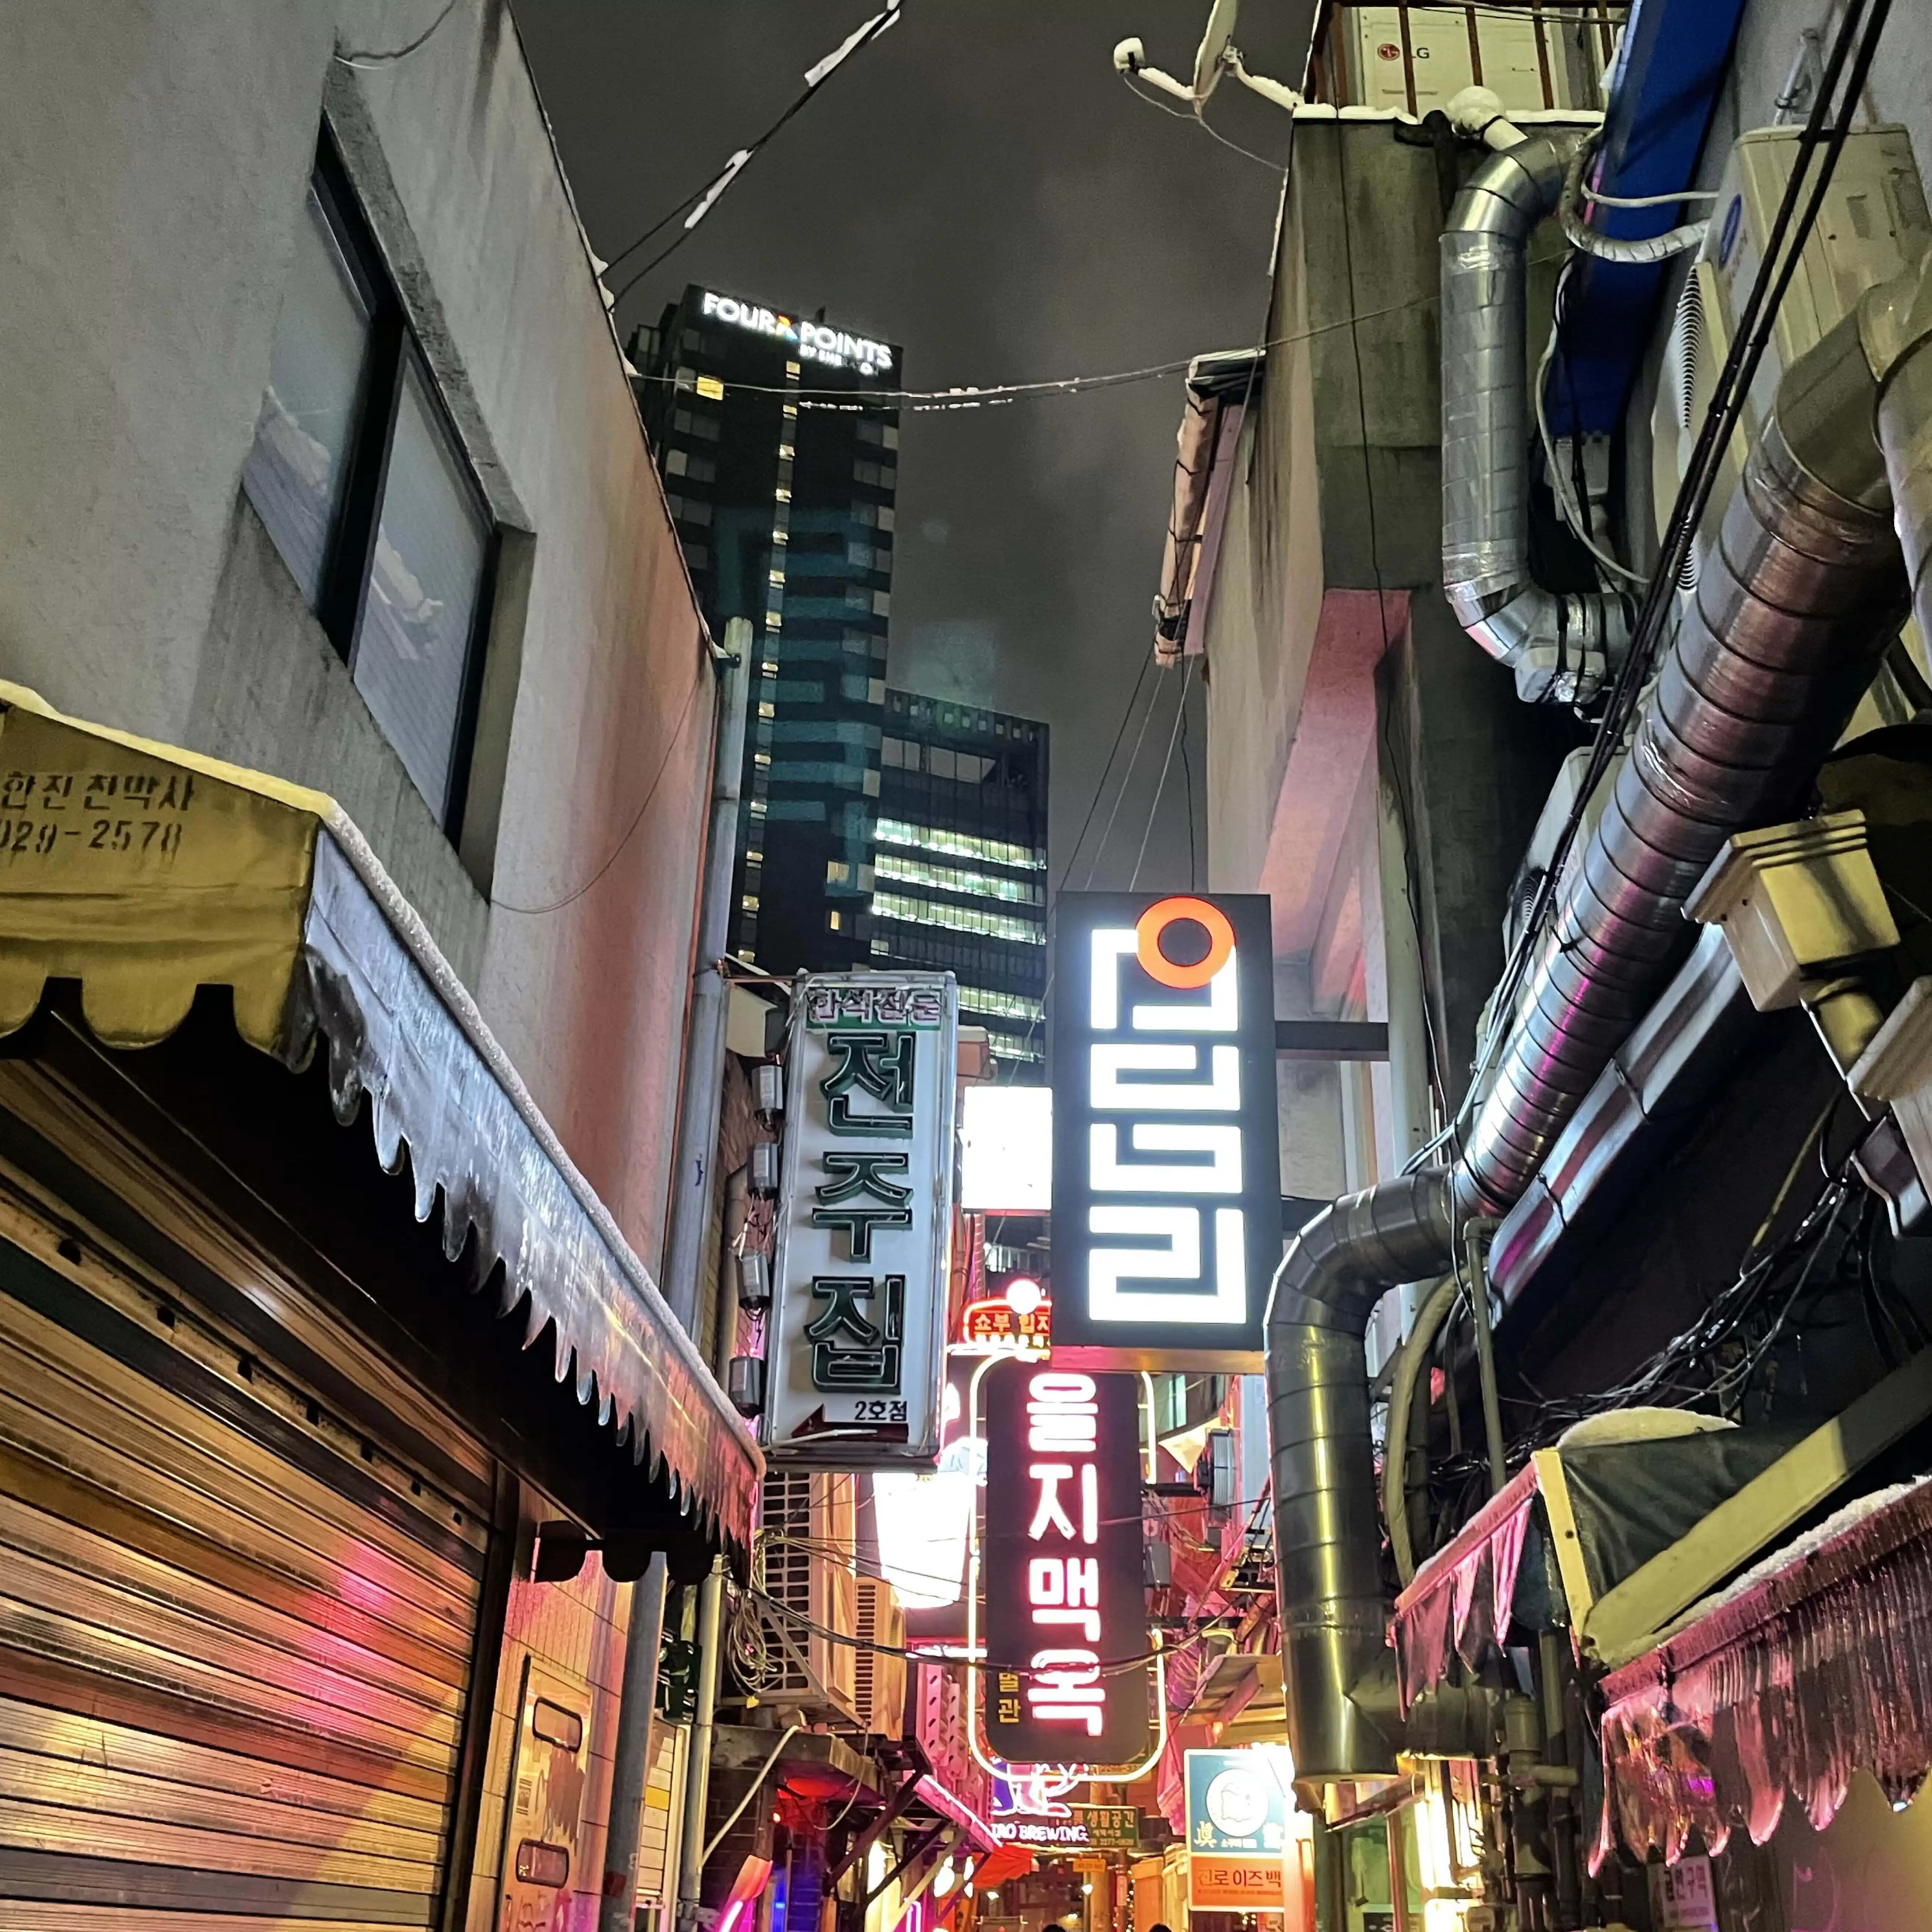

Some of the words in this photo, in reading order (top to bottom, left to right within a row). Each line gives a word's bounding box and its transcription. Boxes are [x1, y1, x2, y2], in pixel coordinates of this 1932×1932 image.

[703, 293, 776, 334] FOUR
[800, 321, 893, 369] POINTS
[804, 1031, 917, 1394] 전주집
[854, 1400, 907, 1421] 2호점
[1027, 1373, 1105, 1736] 을지맥옥
[1018, 1825, 1089, 1842] BREWING
